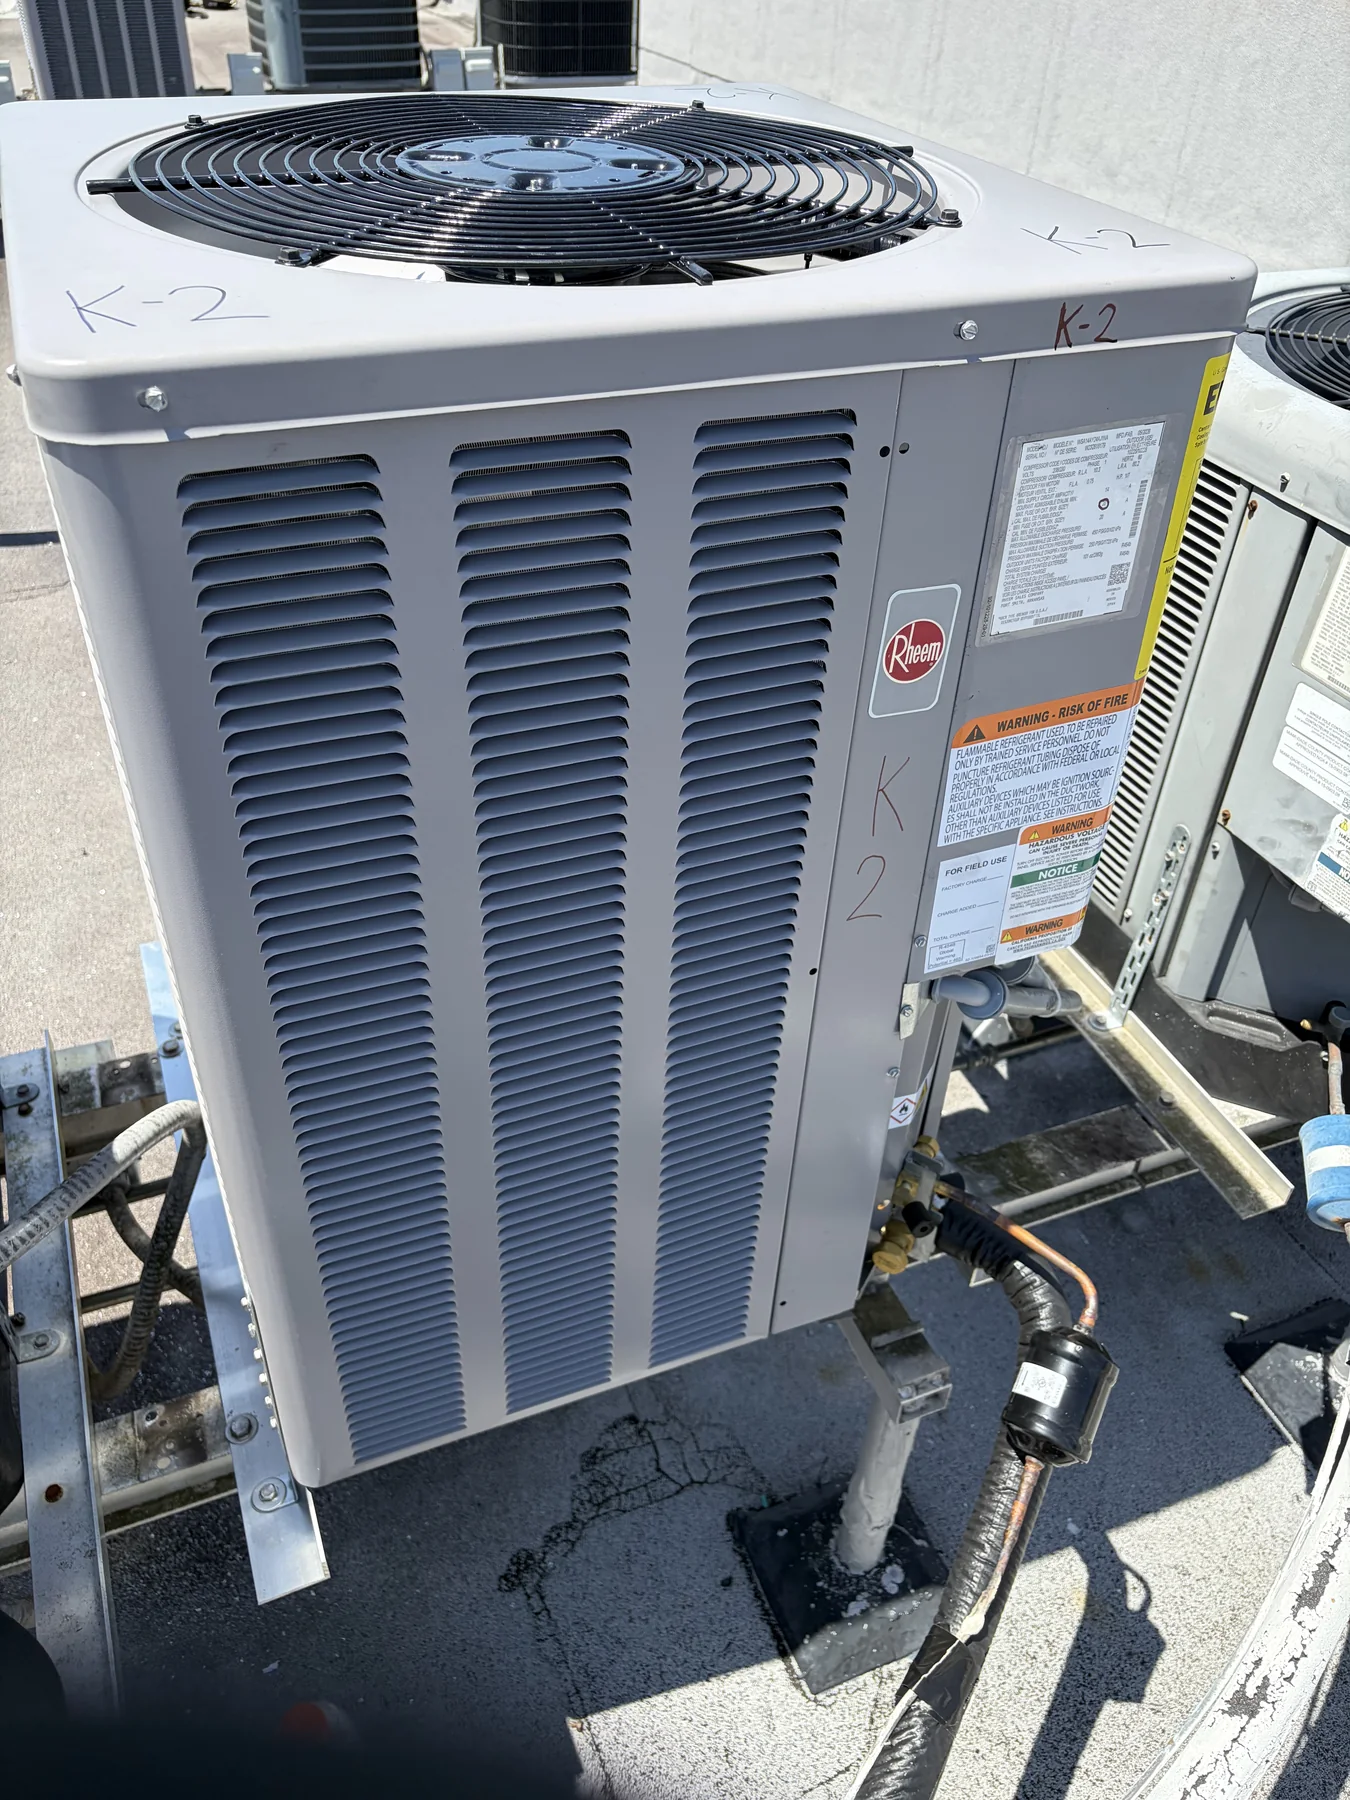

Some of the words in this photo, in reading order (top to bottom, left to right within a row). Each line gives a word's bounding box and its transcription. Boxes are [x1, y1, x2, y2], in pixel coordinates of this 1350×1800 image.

[1020, 225, 1170, 256] K-2
[65, 284, 270, 334] K-2
[1054, 303, 1119, 351] K-2
[888, 622, 942, 674] Rheem
[998, 711, 1049, 732] WARNING
[1059, 703, 1084, 718] RISK
[1087, 699, 1102, 712] OF
[1104, 694, 1128, 708] FIRE
[955, 758, 974, 770] ONLY
[974, 755, 984, 766] BY
[985, 748, 1014, 763] TRAINED
[1015, 741, 1042, 756] SERVICE
[1083, 729, 1094, 740] DO
[1095, 726, 1111, 738] NOT
[956, 741, 999, 759] FLAMMABLE
[1000, 730, 1045, 748] REFRIGERANT
[1067, 723, 1076, 734] TO
[1076, 721, 1086, 732] BE
[1086, 714, 1117, 729] REPAIRED
[951, 777, 985, 793] PROPERLY
[986, 775, 994, 785] IN
[995, 763, 1040, 782] ACCORDANCE
[1042, 760, 1059, 771] WITH
[1060, 753, 1088, 767] FEDERAL
[1090, 750, 1100, 760] OR
[1100, 745, 1119, 758] LOCAL
[953, 766, 990, 783] PUNCTURE
[991, 755, 1036, 773] REFRIGERANT
[1037, 749, 1061, 762] TUBING
[1062, 742, 1090, 757] DISPOSE
[1091, 740, 1101, 750] OF
[1308, 744, 1324, 755] COUNTY
[1324, 754, 1343, 768] PRODUCT
[948, 798, 983, 814] AUXILIARY
[984, 790, 1012, 805] DEVICES
[1013, 785, 1035, 798] WHICH
[1036, 781, 1051, 792] MAY
[1052, 778, 1060, 789] BE
[1061, 772, 1091, 786] IGNITION
[1091, 766, 1114, 780] SOURC-
[1301, 764, 1316, 775] COUNTY
[1317, 774, 1335, 787] PRODUCT
[872, 756, 910, 837] K
[945, 820, 968, 833] OTHER
[969, 815, 987, 827] THAN
[988, 807, 1022, 822] AUXILIARY
[1023, 800, 1050, 814] DEVICES
[1051, 795, 1073, 808] LISTED
[1073, 791, 1087, 802] FOR
[1088, 788, 1101, 799] USE
[947, 814, 955, 823] ES
[956, 809, 976, 821] SHALL
[978, 804, 993, 815] NOT
[994, 802, 1002, 812] BE
[1003, 794, 1038, 809] INSTALLED
[1039, 792, 1046, 800] IN
[1048, 788, 1060, 798] THE
[950, 784, 996, 803] REGULATIONS.
[944, 832, 961, 843] WITH
[963, 828, 975, 839] THE
[976, 821, 1004, 835] SPECIFIC
[1043, 808, 1055, 819] SEE
[1029, 834, 1074, 848] HAZARDOUS
[1052, 818, 1093, 834] WARNING
[946, 867, 962, 876] FOR
[965, 861, 988, 871] FIELD
[991, 856, 1007, 865] USE
[1039, 864, 1077, 880] NOTICE
[846, 854, 886, 922] 2
[942, 882, 965, 891] FACTORY
[966, 877, 987, 885] CHARGE
[937, 909, 958, 917] CHARGE
[1026, 919, 1063, 934] WARNING
[950, 930, 970, 938] CHARGE
